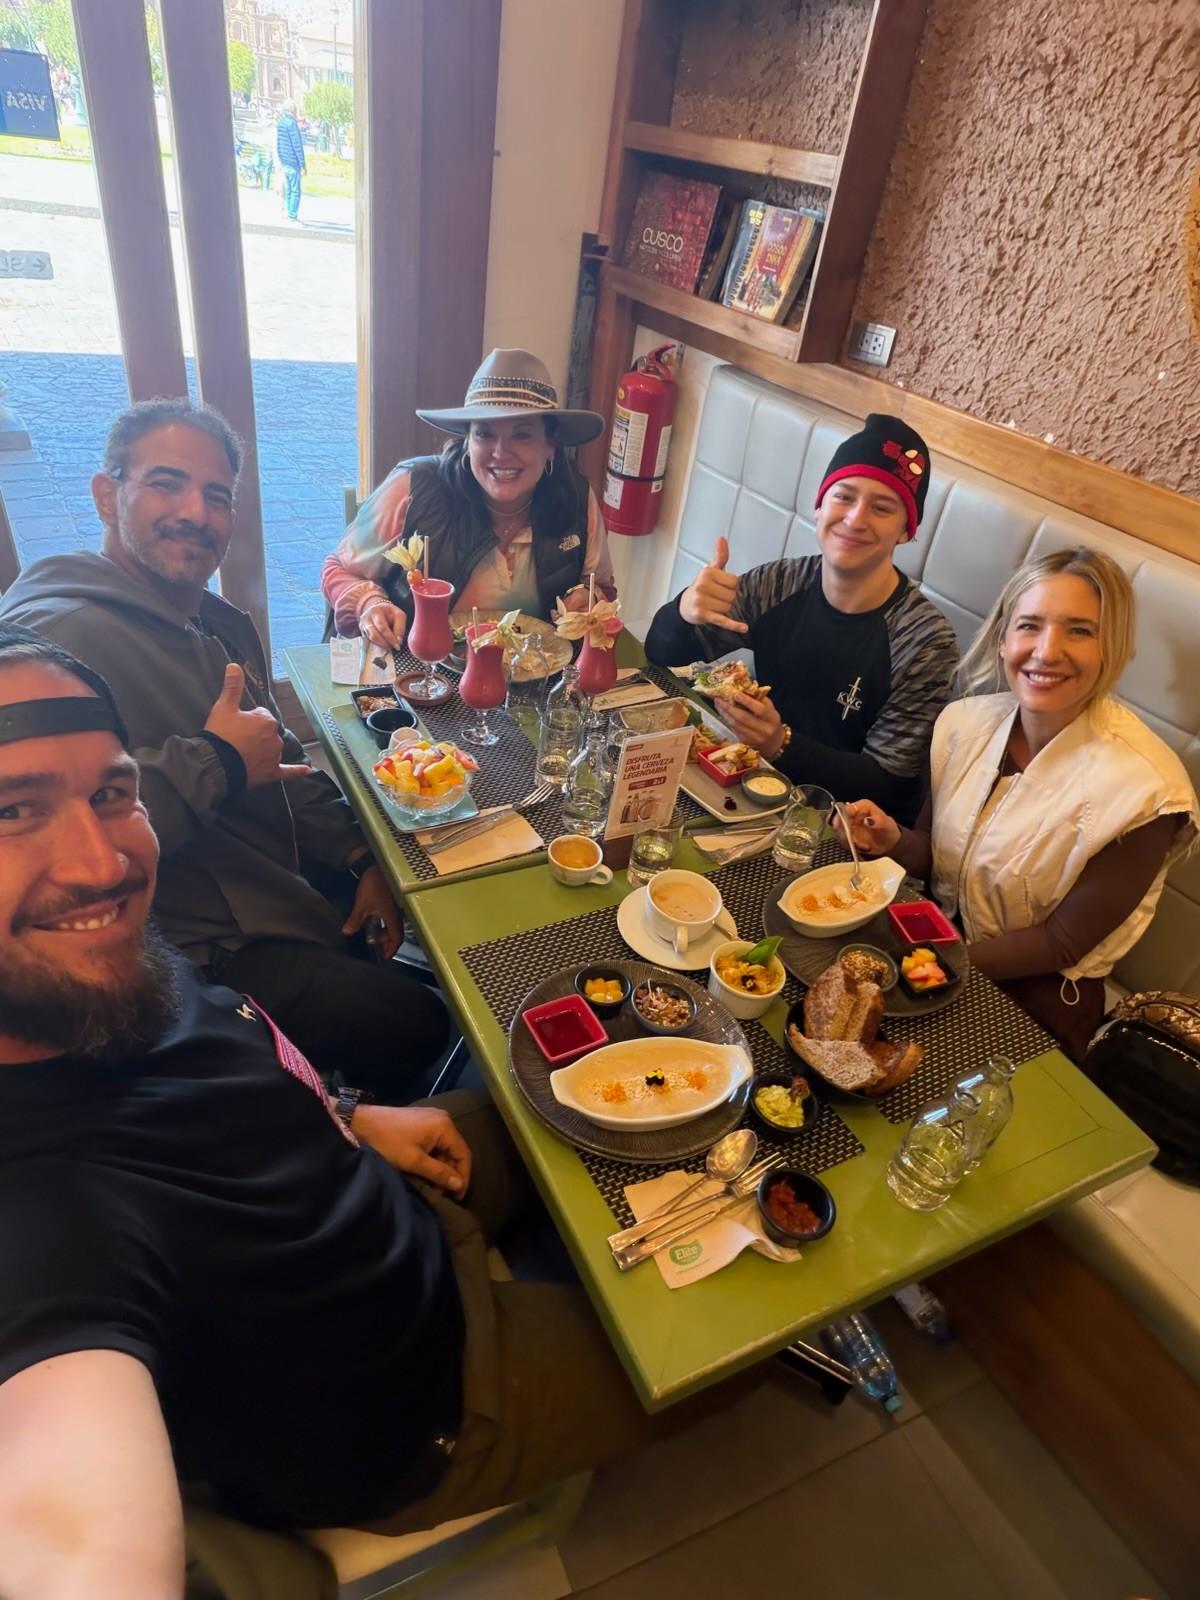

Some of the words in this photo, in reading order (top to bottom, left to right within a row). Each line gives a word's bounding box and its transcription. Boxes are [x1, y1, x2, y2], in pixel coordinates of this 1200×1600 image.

[642, 227, 684, 253] CUSCO
[624, 763, 641, 773] UNA
[642, 756, 674, 769] CERVEZA
[626, 752, 661, 765] DISFRUTA
[622, 765, 668, 780] LEGENDARIA
